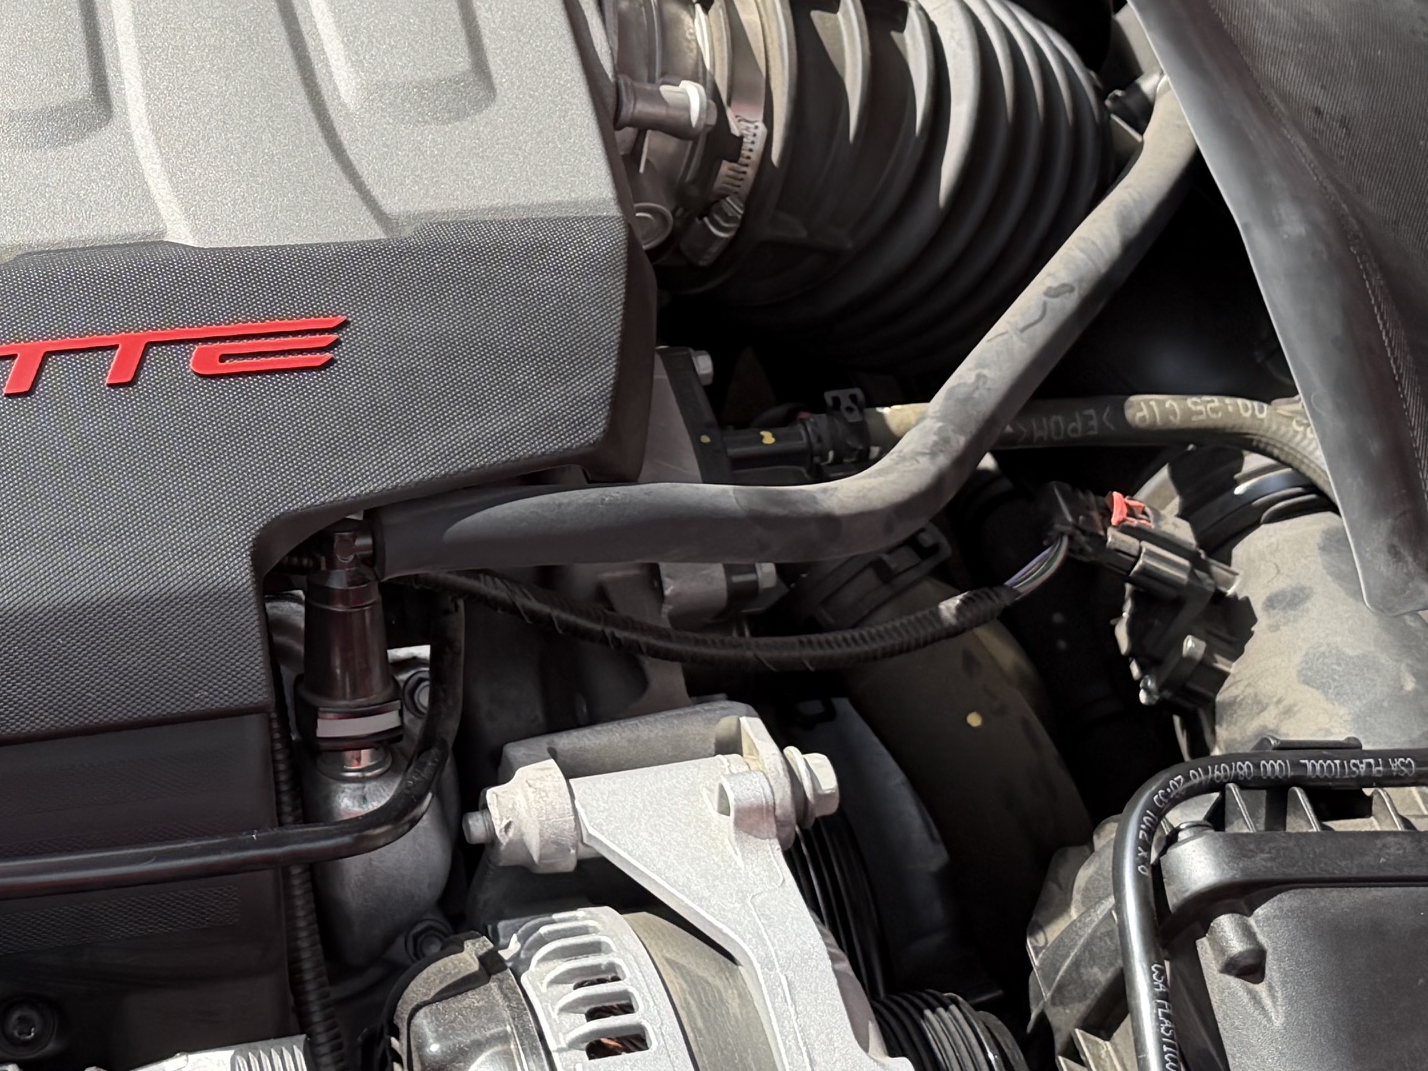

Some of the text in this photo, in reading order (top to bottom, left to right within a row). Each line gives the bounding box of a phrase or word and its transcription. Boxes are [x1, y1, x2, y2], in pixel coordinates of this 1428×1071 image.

[1260, 759, 1291, 779] 1000
[1299, 758, 1383, 778] PLASTICOOL
[1388, 757, 1415, 777] CSA
